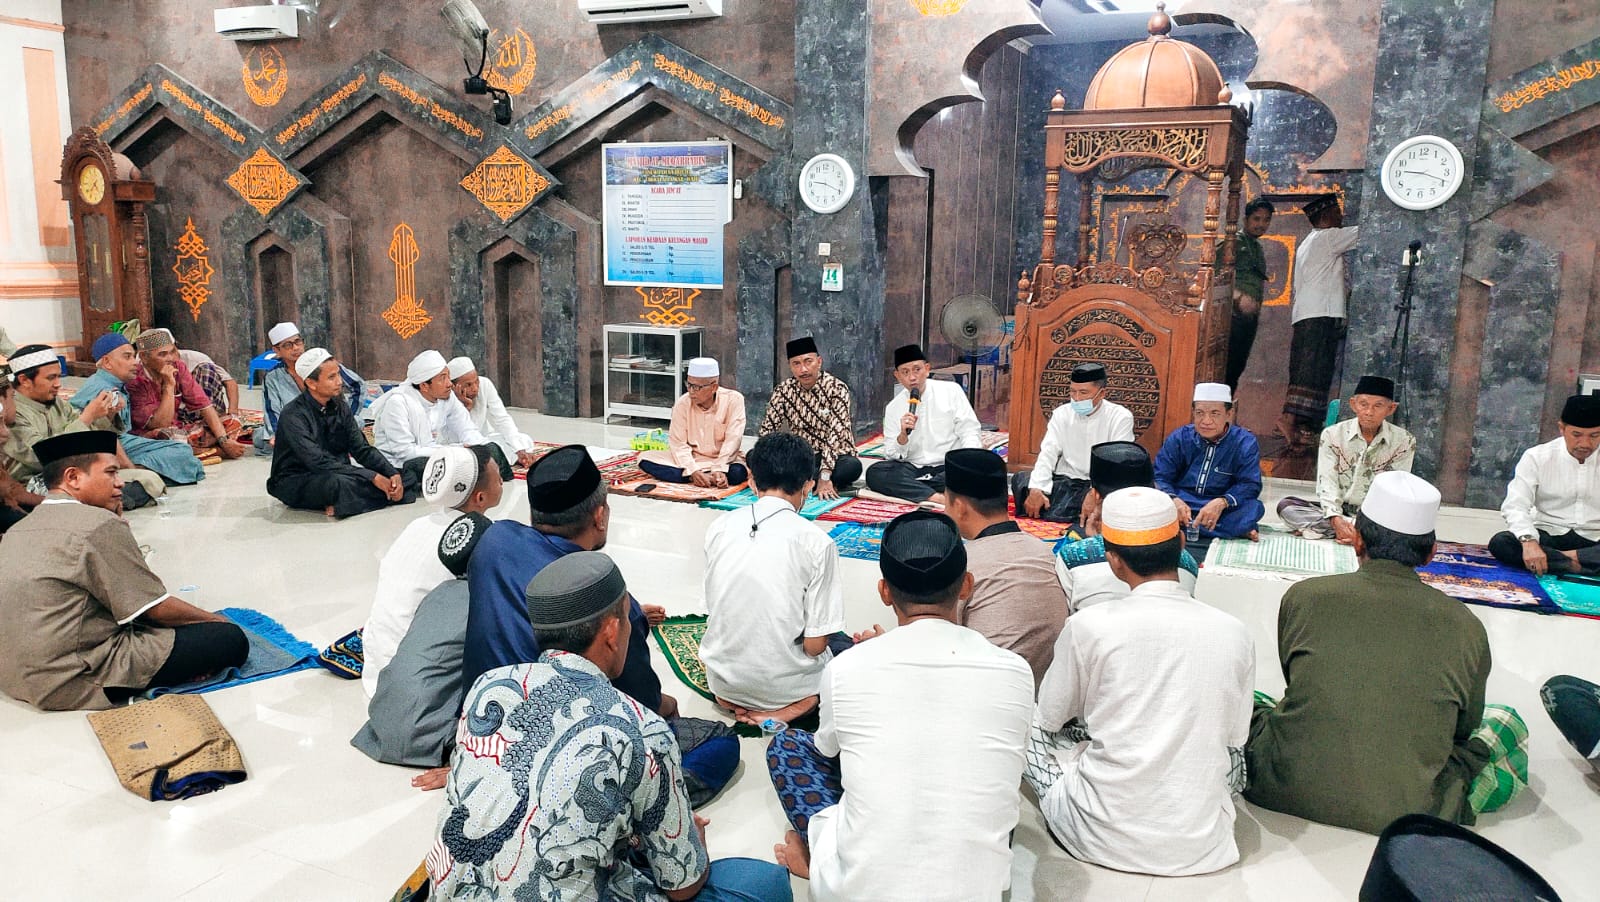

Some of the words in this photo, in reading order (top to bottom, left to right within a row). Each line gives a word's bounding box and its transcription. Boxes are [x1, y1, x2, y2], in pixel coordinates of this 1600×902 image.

[1408, 151, 1416, 159] 11
[1420, 147, 1430, 156] 12
[1434, 150, 1438, 158] 1
[1399, 159, 1407, 167] 10
[1440, 158, 1447, 166] 2
[1395, 170, 1401, 178] 9
[1444, 168, 1450, 176] 3
[1406, 188, 1412, 196] 7
[826, 268, 837, 280] 14
